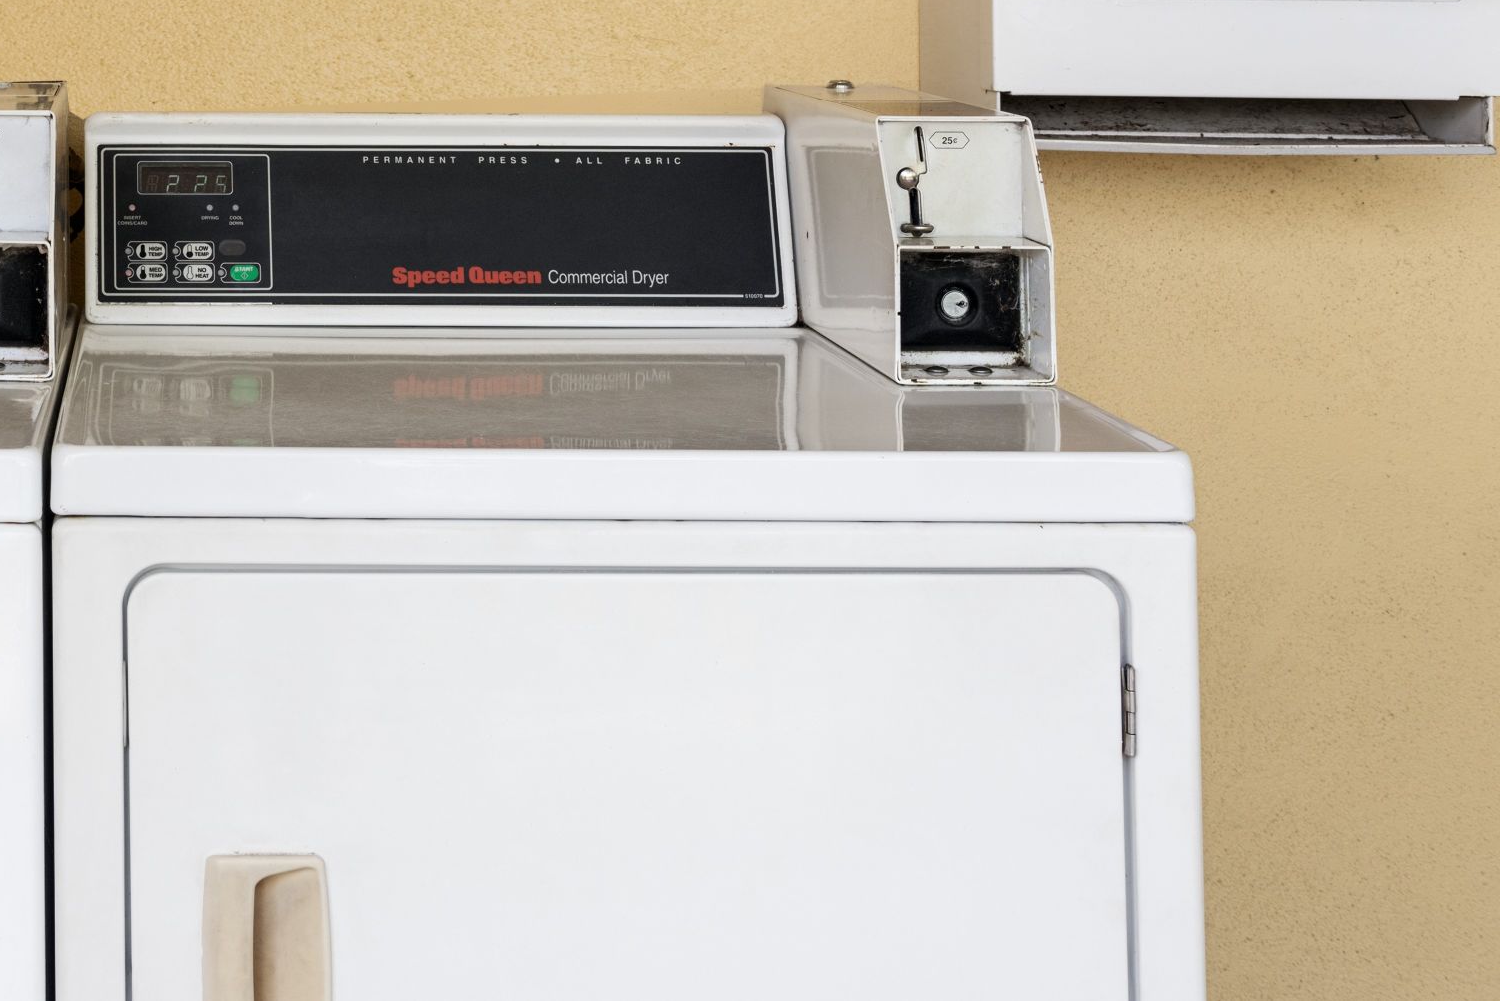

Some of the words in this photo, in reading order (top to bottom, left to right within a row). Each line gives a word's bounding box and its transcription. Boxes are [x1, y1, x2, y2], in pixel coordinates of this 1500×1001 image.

[941, 136, 958, 145] 25¢
[362, 156, 457, 164] PERMANENT
[477, 156, 529, 165] PRESS
[575, 156, 603, 165] ALL
[624, 156, 682, 165] FABRIC
[392, 266, 465, 288] Speed
[468, 266, 542, 285] Queen
[547, 269, 628, 285] Commercial
[632, 269, 670, 288] Dryer
